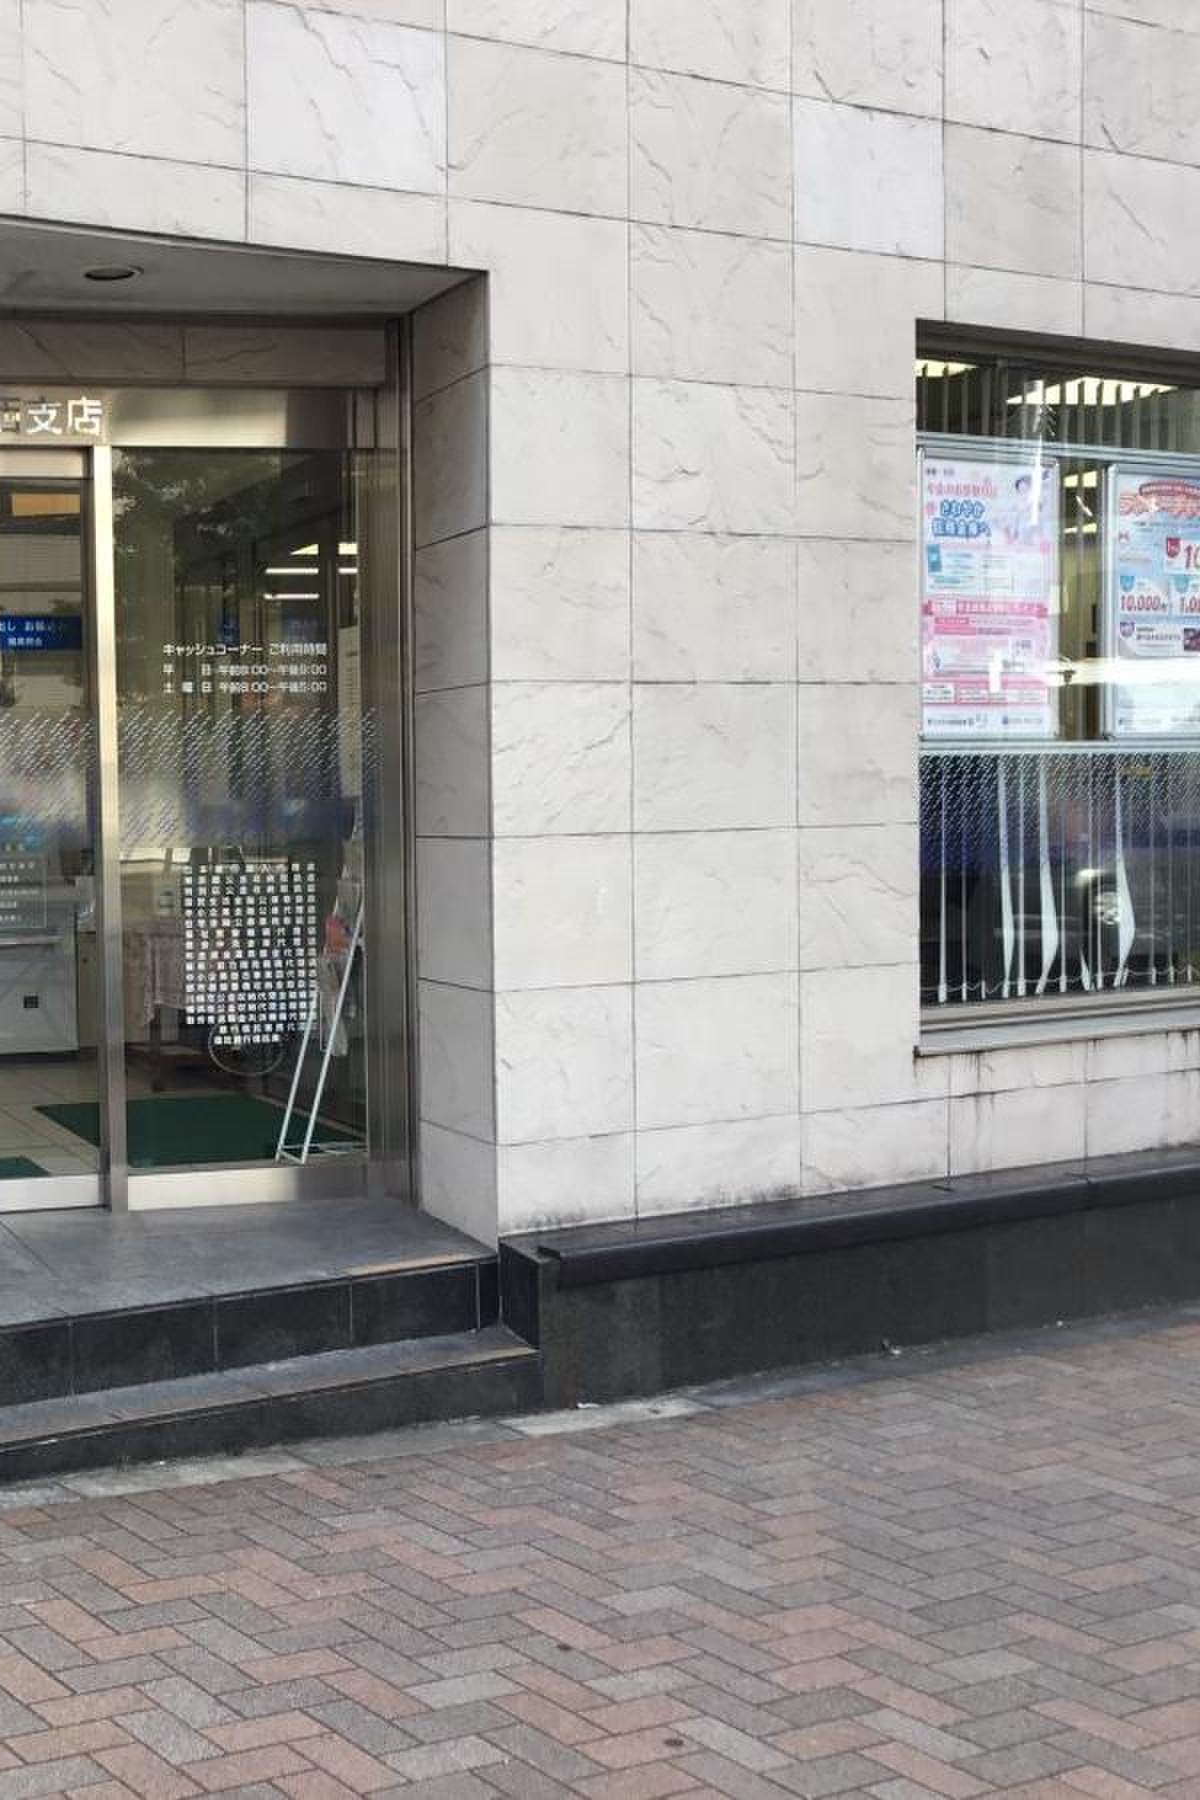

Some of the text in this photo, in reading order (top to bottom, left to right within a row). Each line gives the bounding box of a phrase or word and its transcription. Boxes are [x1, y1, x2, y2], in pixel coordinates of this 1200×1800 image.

[163, 642, 328, 656] キャッシュコーナー ご利用時間
